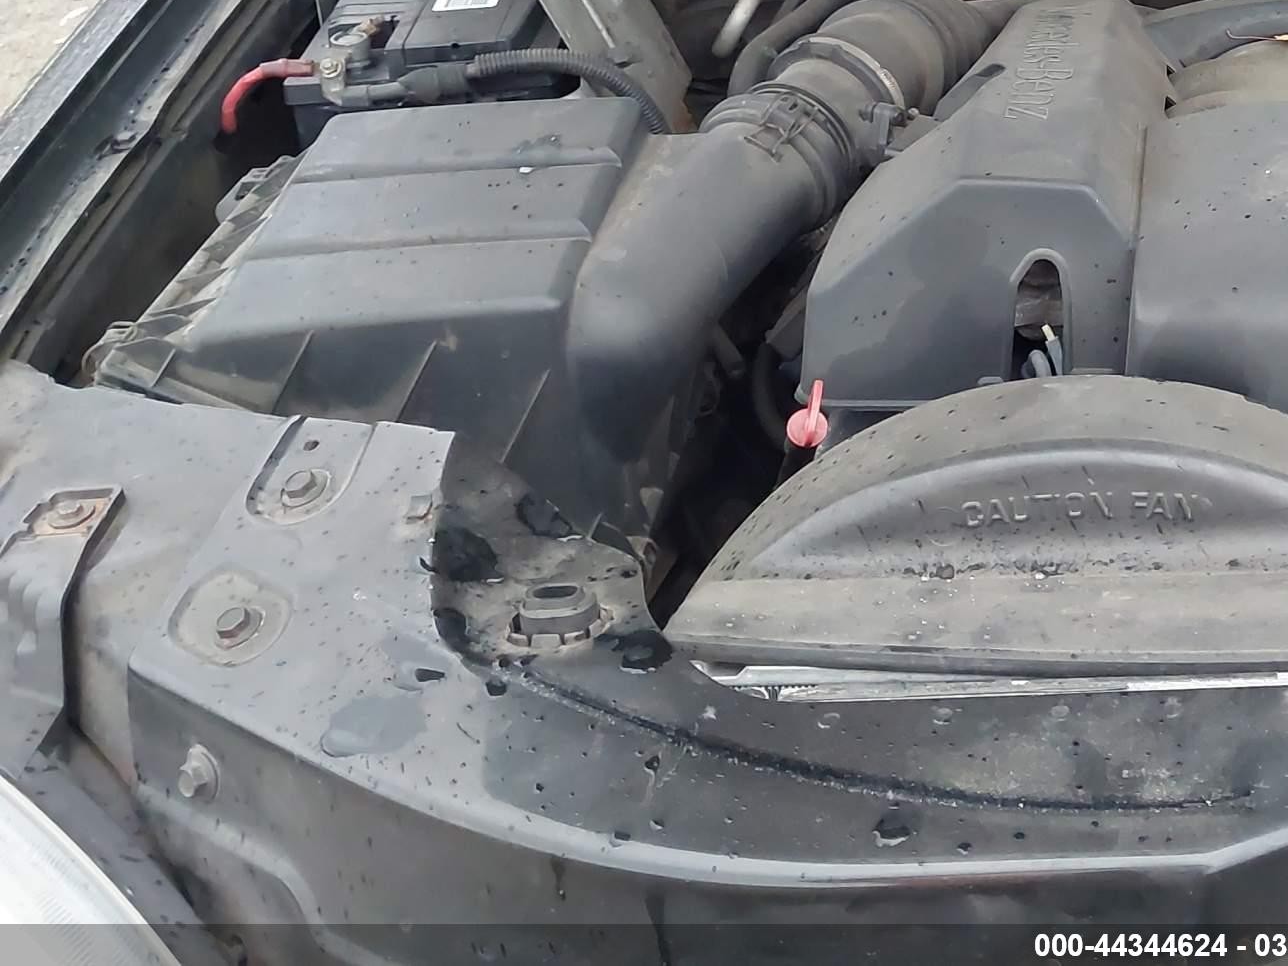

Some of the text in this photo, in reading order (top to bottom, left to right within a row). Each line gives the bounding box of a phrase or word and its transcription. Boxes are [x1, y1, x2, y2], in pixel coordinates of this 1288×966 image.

[1003, 3, 1093, 121] Mercedes-Benz
[960, 490, 1199, 528] CAUTION FAN
